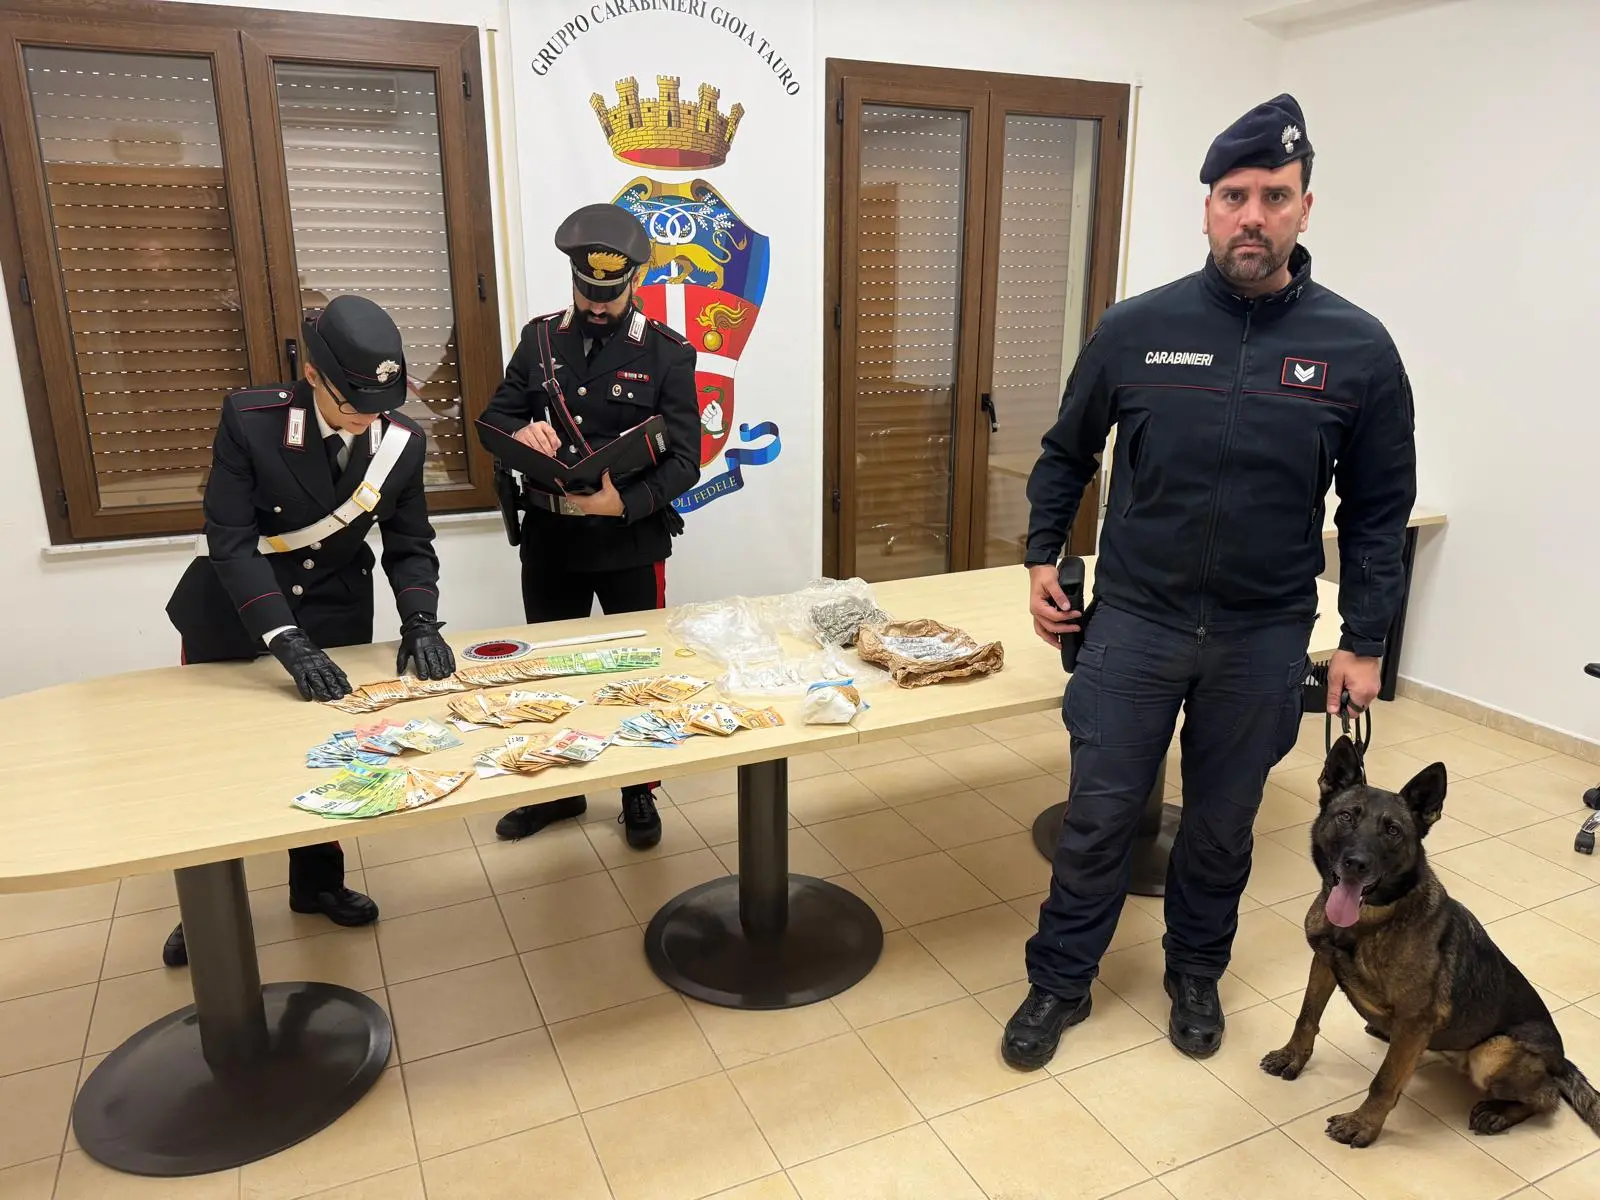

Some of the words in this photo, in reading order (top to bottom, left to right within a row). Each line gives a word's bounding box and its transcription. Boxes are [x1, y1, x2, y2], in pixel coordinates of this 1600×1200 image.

[531, 14, 590, 76] GRUPPO
[590, 0, 706, 24] CARABINIERI
[710, 6, 755, 47] GIOIA
[756, 38, 801, 96] TAURO
[1145, 351, 1214, 366] CARABINIERI
[694, 475, 738, 503] FEDELE
[310, 783, 337, 796] 100
